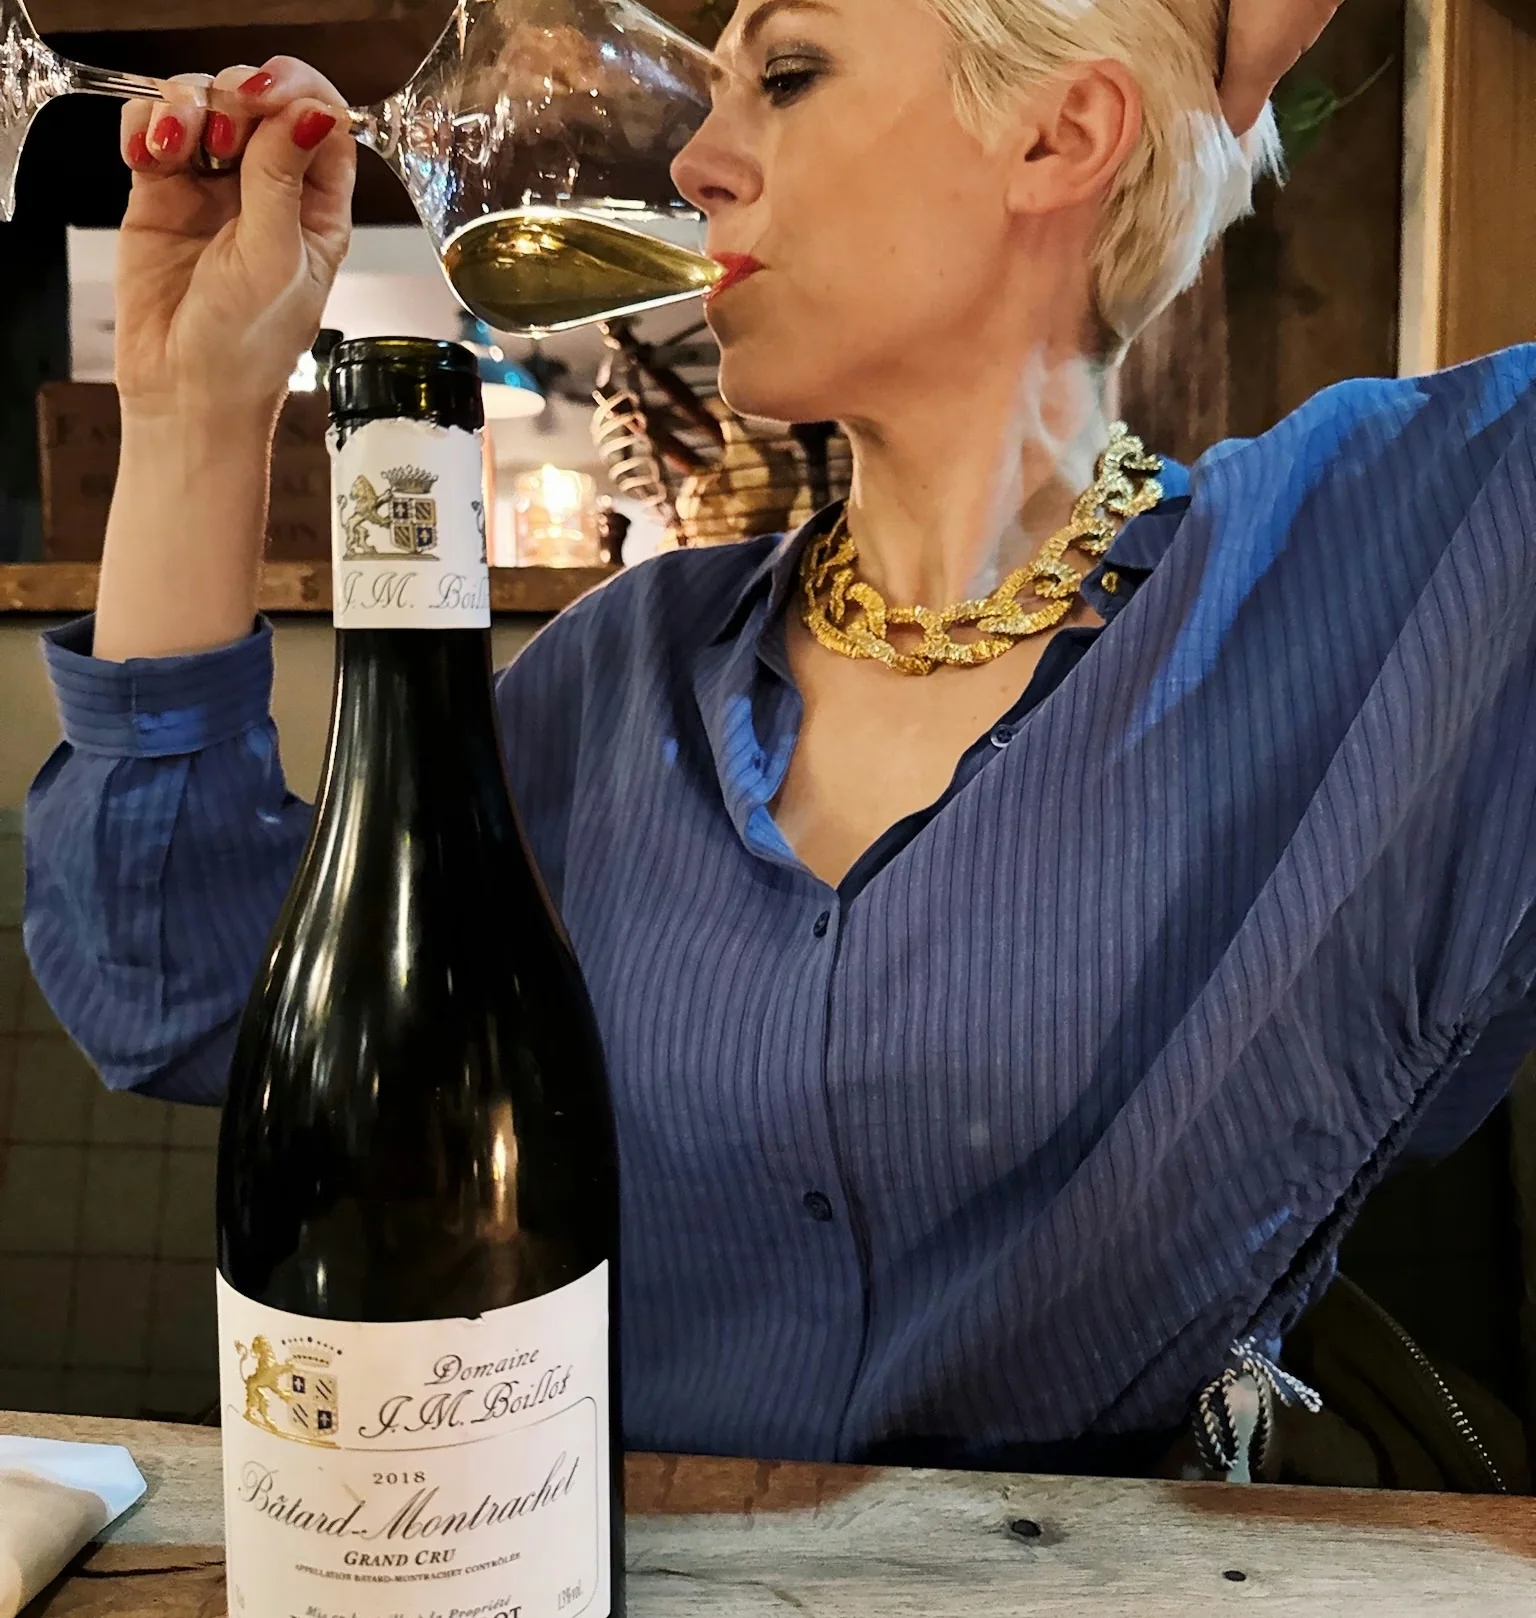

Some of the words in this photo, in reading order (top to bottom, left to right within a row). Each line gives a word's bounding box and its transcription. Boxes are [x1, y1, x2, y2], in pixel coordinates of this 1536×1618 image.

[424, 1348, 539, 1386] Domaine
[470, 1364, 573, 1424] Boillot
[372, 1470, 427, 1485] 2018
[344, 1550, 409, 1567] GRAND
[414, 1548, 457, 1566] CRU
